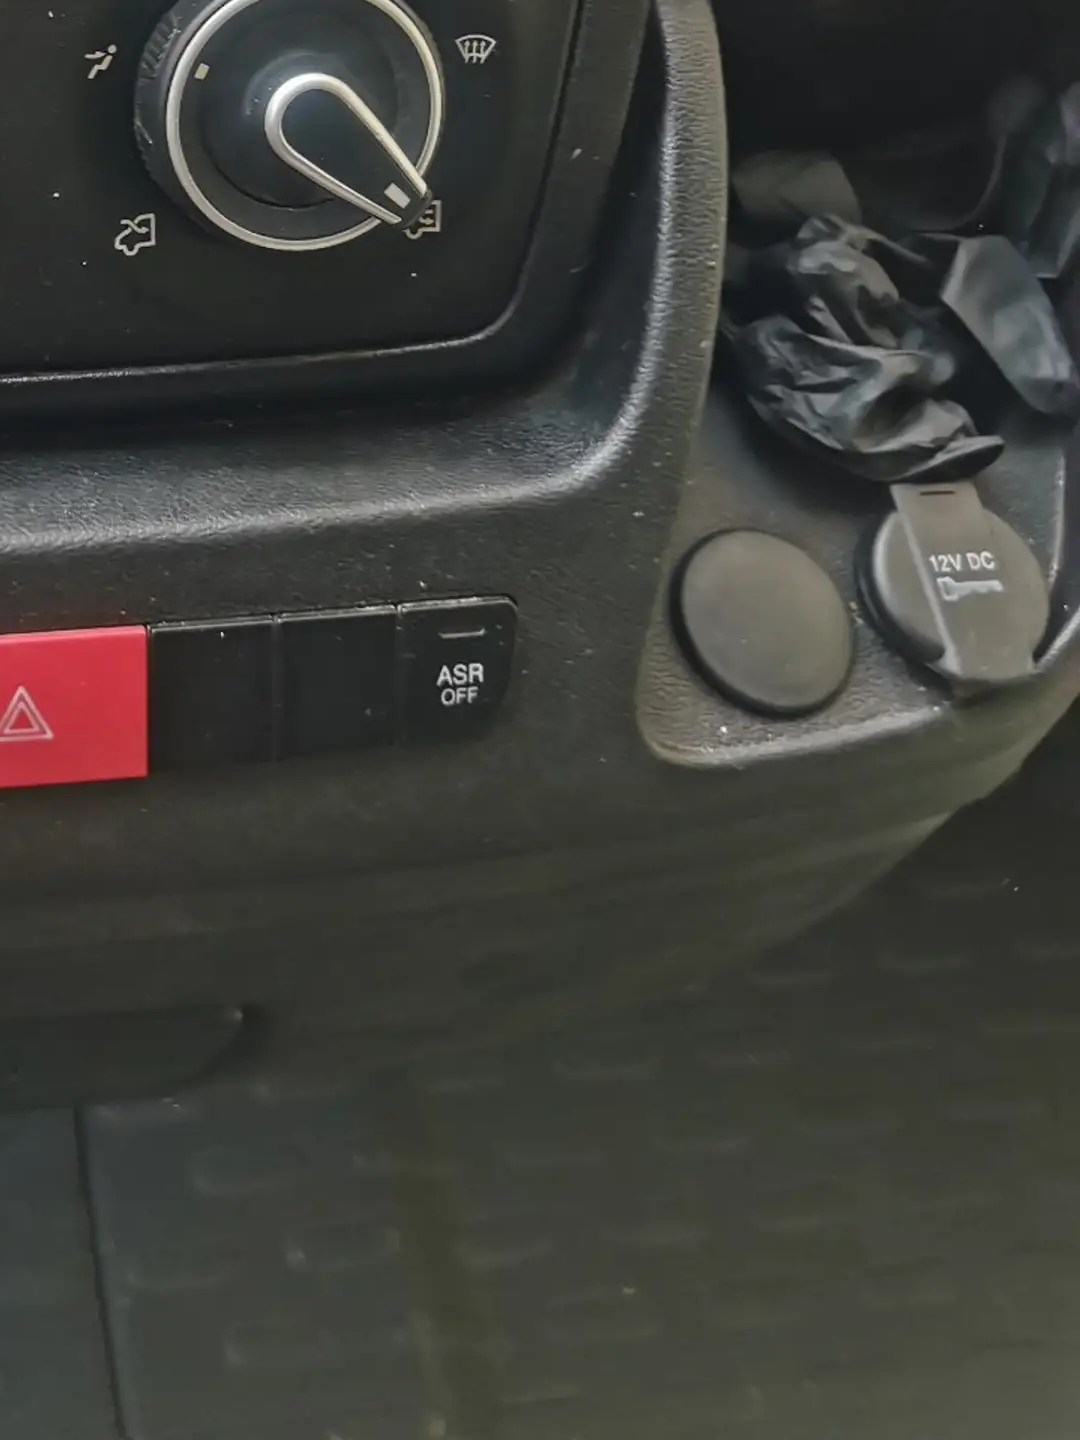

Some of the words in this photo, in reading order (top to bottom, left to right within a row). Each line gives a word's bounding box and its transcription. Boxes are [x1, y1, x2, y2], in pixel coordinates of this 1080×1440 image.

[929, 553, 962, 572] 12V
[966, 551, 996, 571] DC
[436, 663, 484, 687] ASR
[441, 686, 479, 706] OFF
